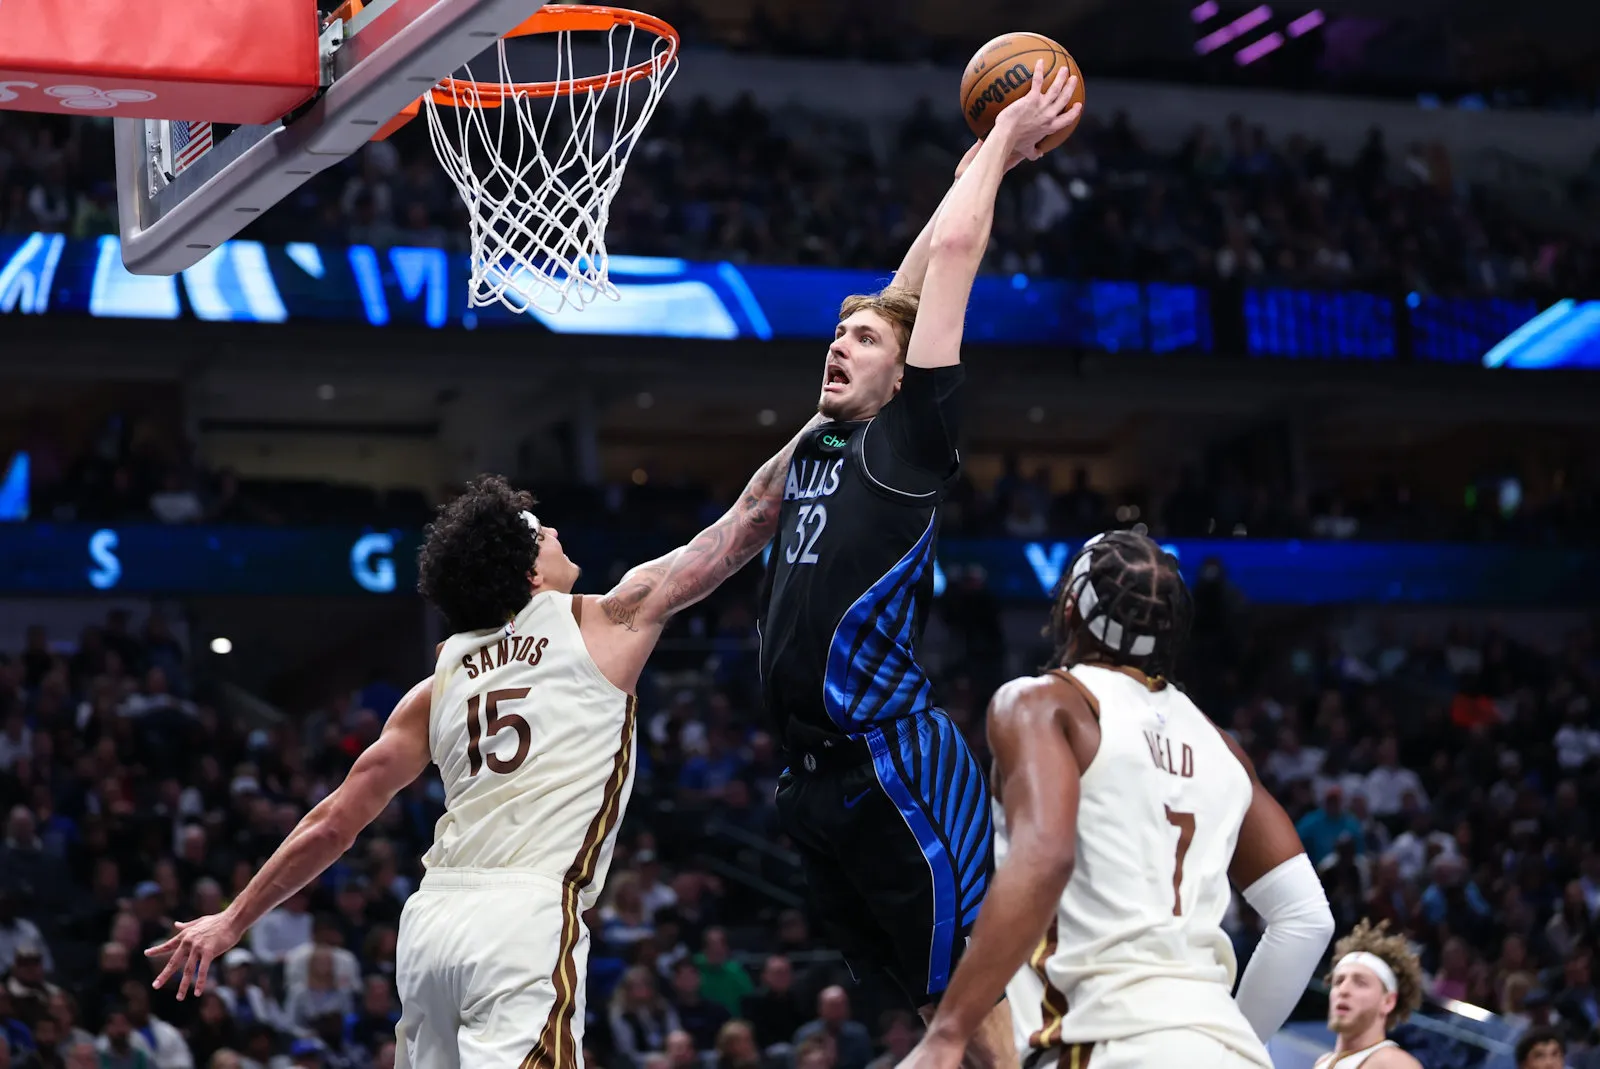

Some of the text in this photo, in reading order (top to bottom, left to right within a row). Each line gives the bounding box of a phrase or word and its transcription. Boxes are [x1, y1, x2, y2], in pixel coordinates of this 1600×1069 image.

[969, 63, 1034, 121] Wilson
[823, 435, 847, 448] chi
[783, 458, 845, 500] ALLAS
[786, 504, 827, 564] 32
[462, 636, 549, 680] SANTOS
[467, 687, 531, 777] 15
[1164, 803, 1196, 917] 7
